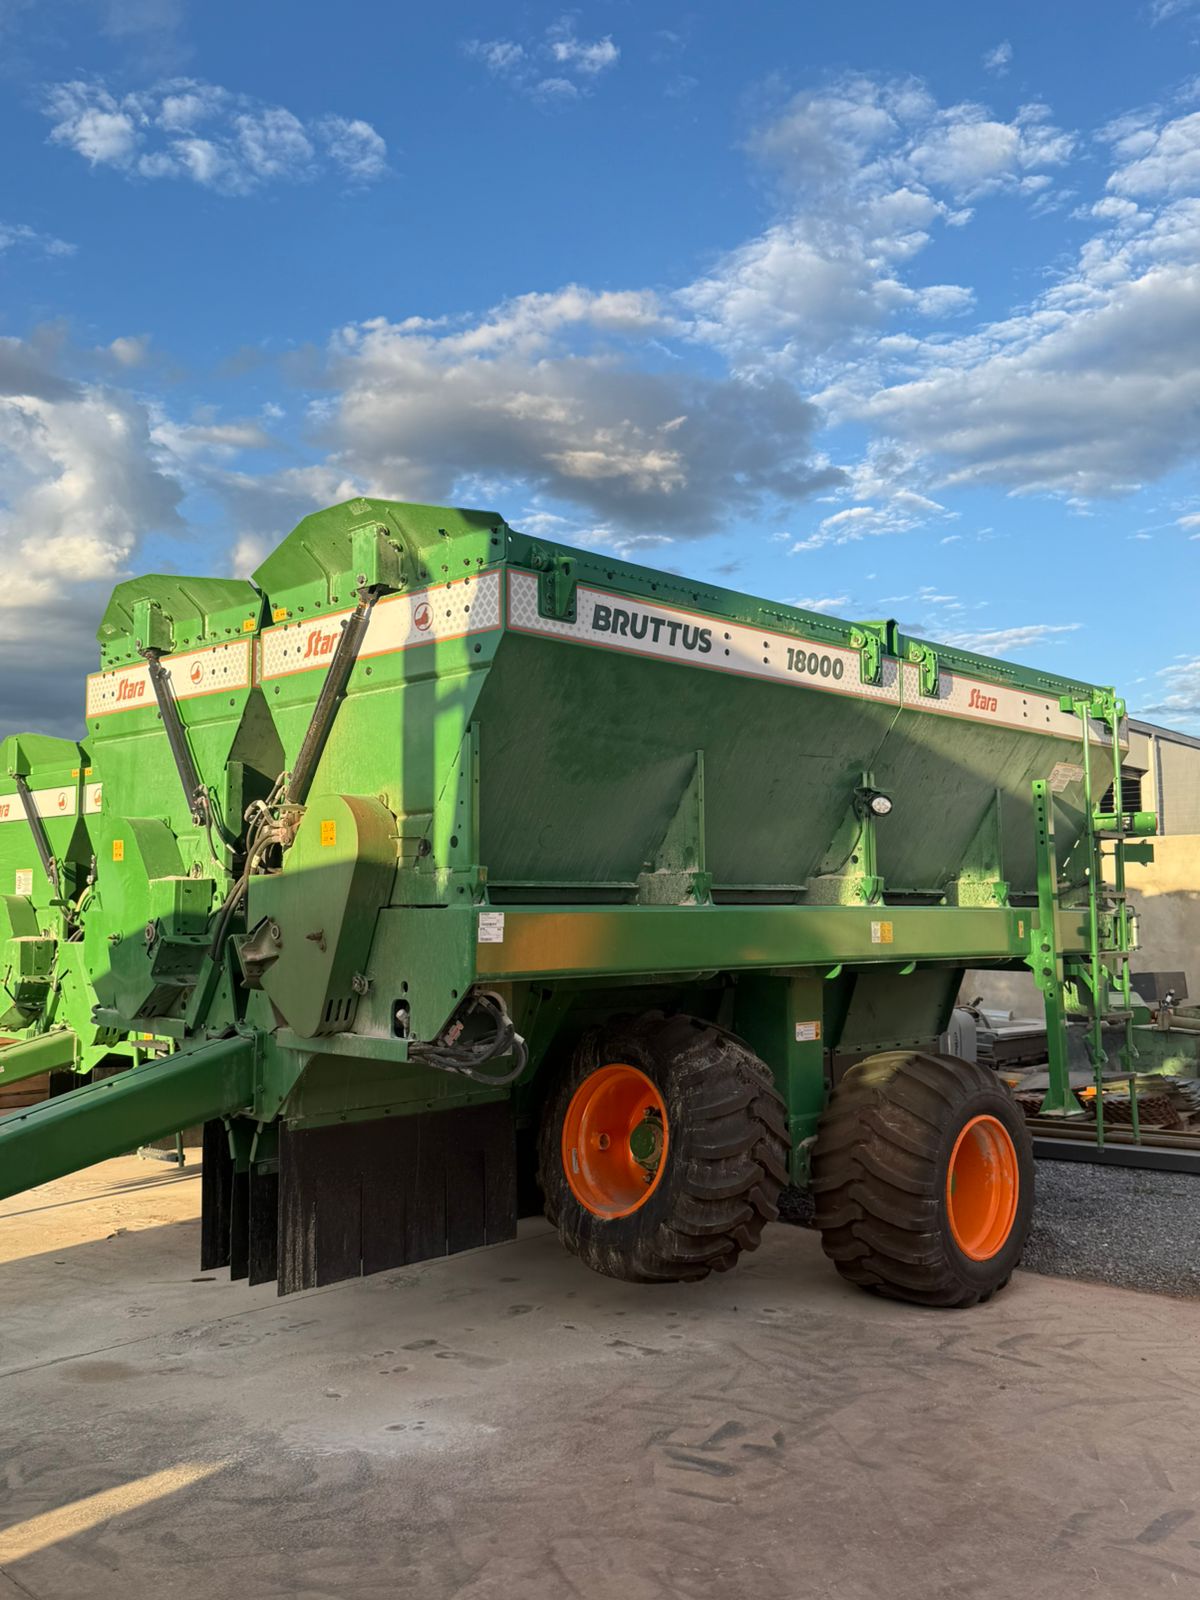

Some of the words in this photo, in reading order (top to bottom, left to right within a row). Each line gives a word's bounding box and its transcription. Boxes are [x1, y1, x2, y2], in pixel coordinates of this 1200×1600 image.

[303, 629, 342, 659] Star
[591, 603, 712, 654] BRUTTUS
[786, 647, 844, 681] 18000
[116, 678, 146, 702] Stara
[968, 688, 998, 713] Stara
